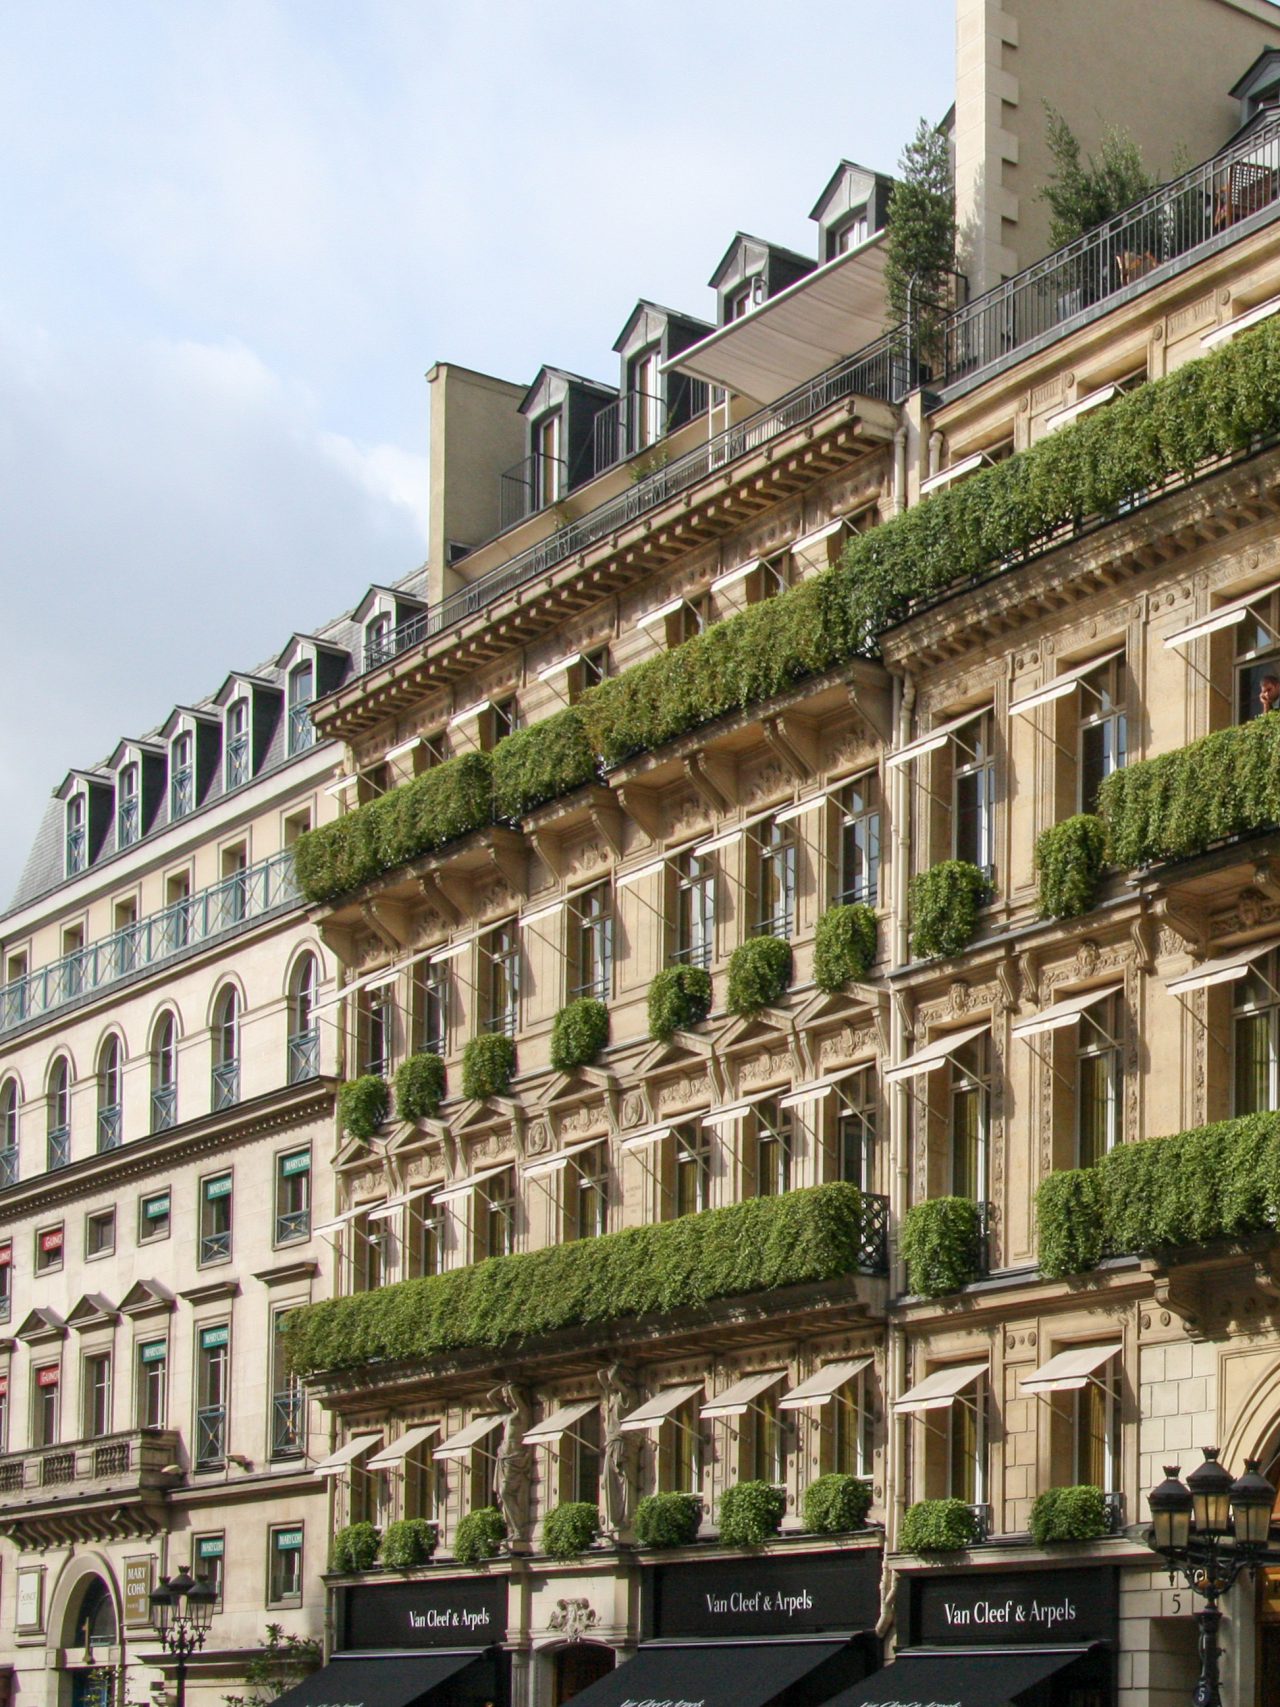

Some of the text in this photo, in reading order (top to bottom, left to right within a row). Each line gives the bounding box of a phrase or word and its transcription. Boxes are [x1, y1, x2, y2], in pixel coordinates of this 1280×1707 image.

[128, 1567, 145, 1580] MARY
[128, 1582, 146, 1596] COHR
[706, 1589, 813, 1616] Van Cleef & Arpels
[1172, 1594, 1181, 1614] 5
[409, 1607, 490, 1631] Van Cleef & Arpels
[944, 1598, 1076, 1628] Van Cleef & Arpels
[1198, 1688, 1205, 1701] 5
